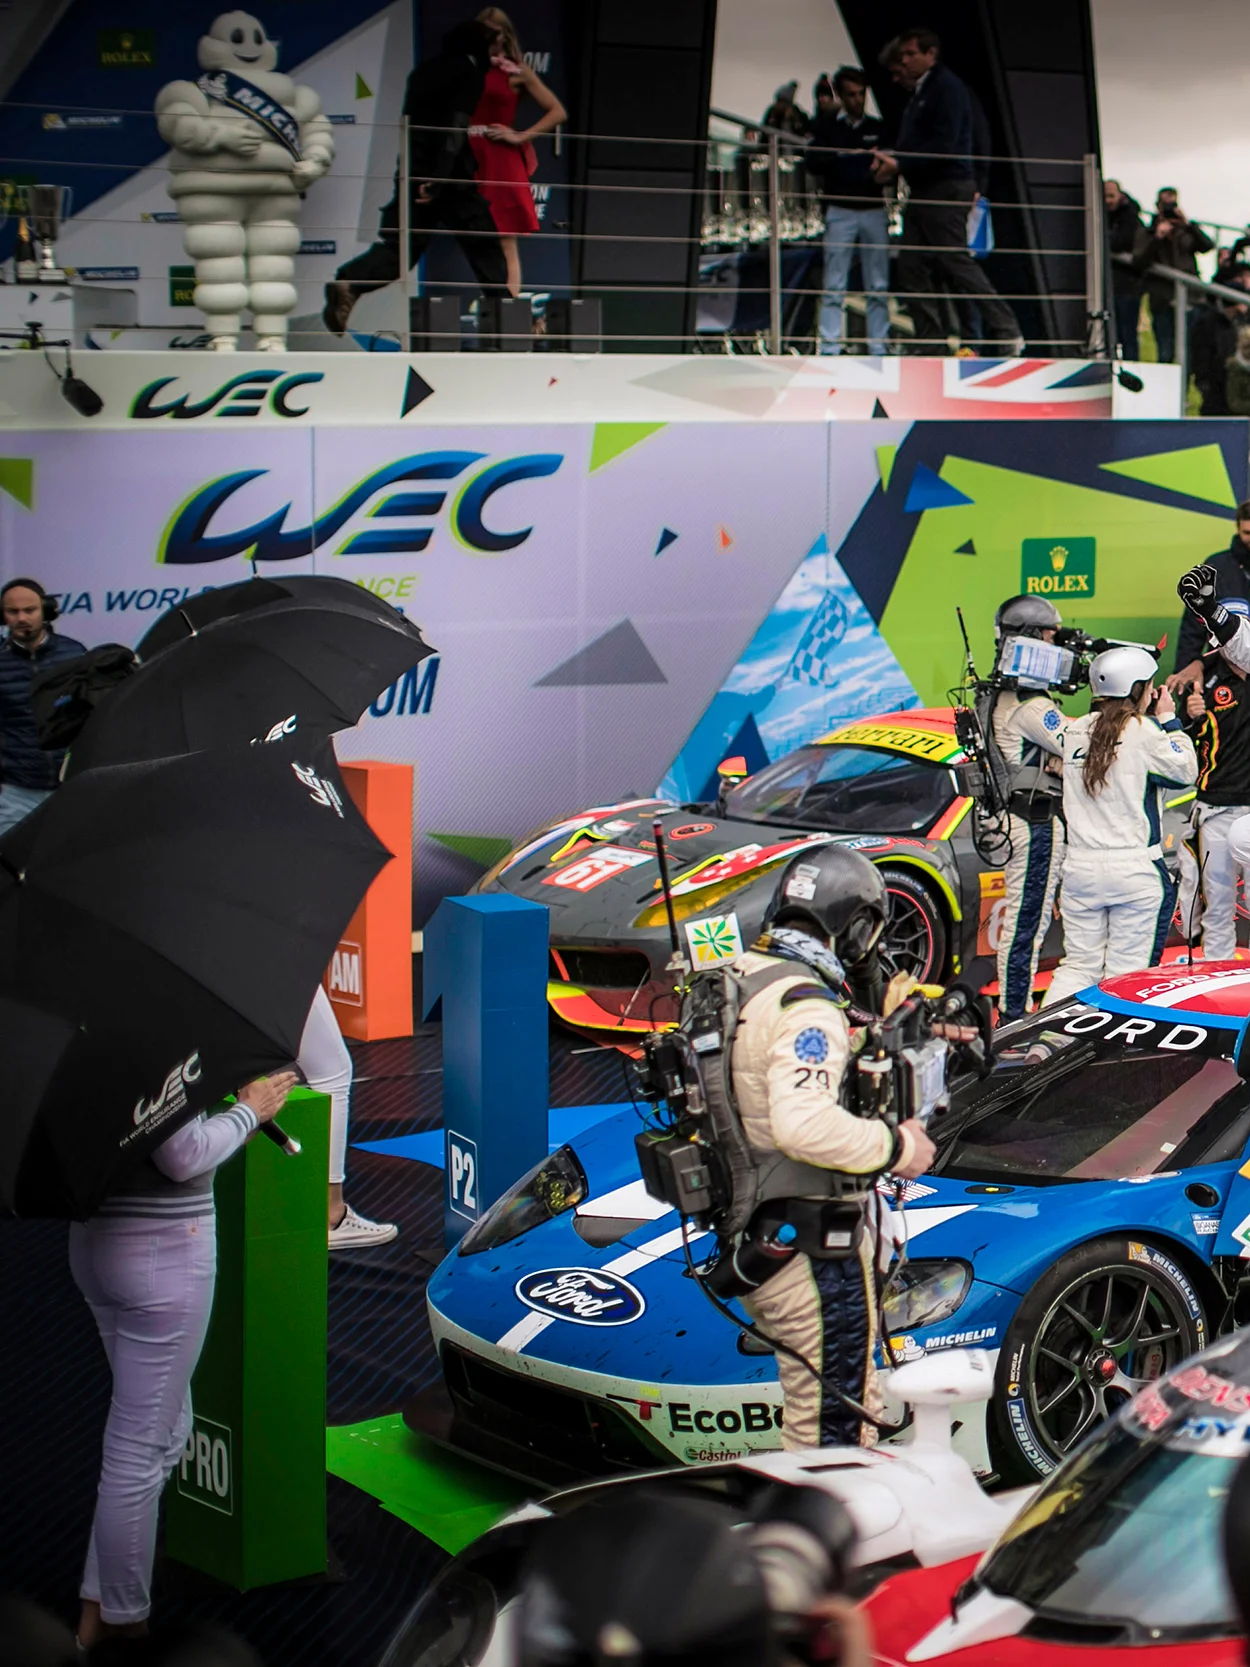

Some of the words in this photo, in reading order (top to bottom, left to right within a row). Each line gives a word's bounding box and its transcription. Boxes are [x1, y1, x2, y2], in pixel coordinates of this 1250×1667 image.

[101, 51, 151, 63] ROLEX
[127, 369, 325, 419] WEC
[155, 450, 564, 564] WEC
[1027, 575, 1090, 593] ROLEX
[330, 952, 360, 996] AM
[1135, 974, 1213, 999] FORD
[1037, 1001, 1208, 1051] FORD
[133, 1052, 202, 1126] WEC
[794, 1066, 830, 1090] 29
[128, 1119, 151, 1141] WORLD
[451, 1143, 476, 1210] P2
[529, 1272, 624, 1317] Ford
[1152, 1253, 1199, 1312] MICHELIN
[925, 1327, 997, 1349] MICHELIN
[182, 1430, 229, 1497] PRO
[1009, 1404, 1055, 1476] MICHELIN
